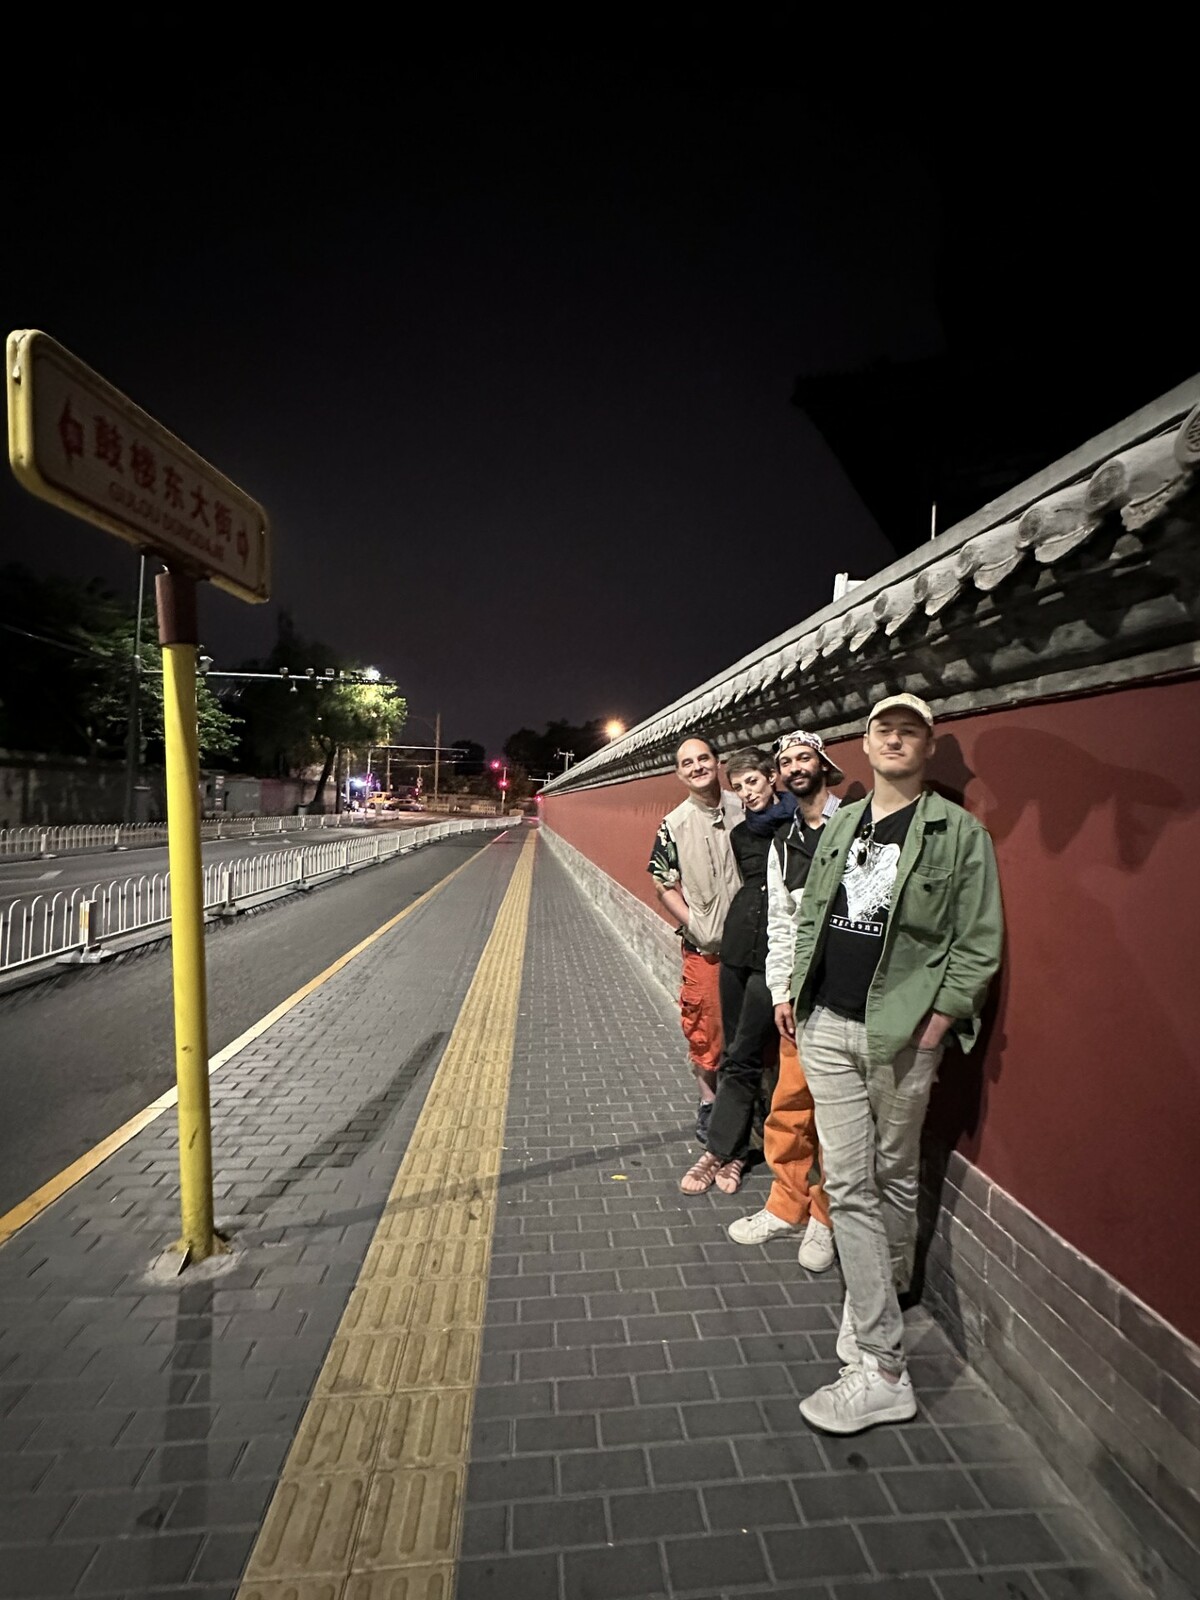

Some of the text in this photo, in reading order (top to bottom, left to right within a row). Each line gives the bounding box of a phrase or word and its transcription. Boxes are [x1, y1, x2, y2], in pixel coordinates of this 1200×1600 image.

[93, 415, 232, 542] 鼓楼东大街
